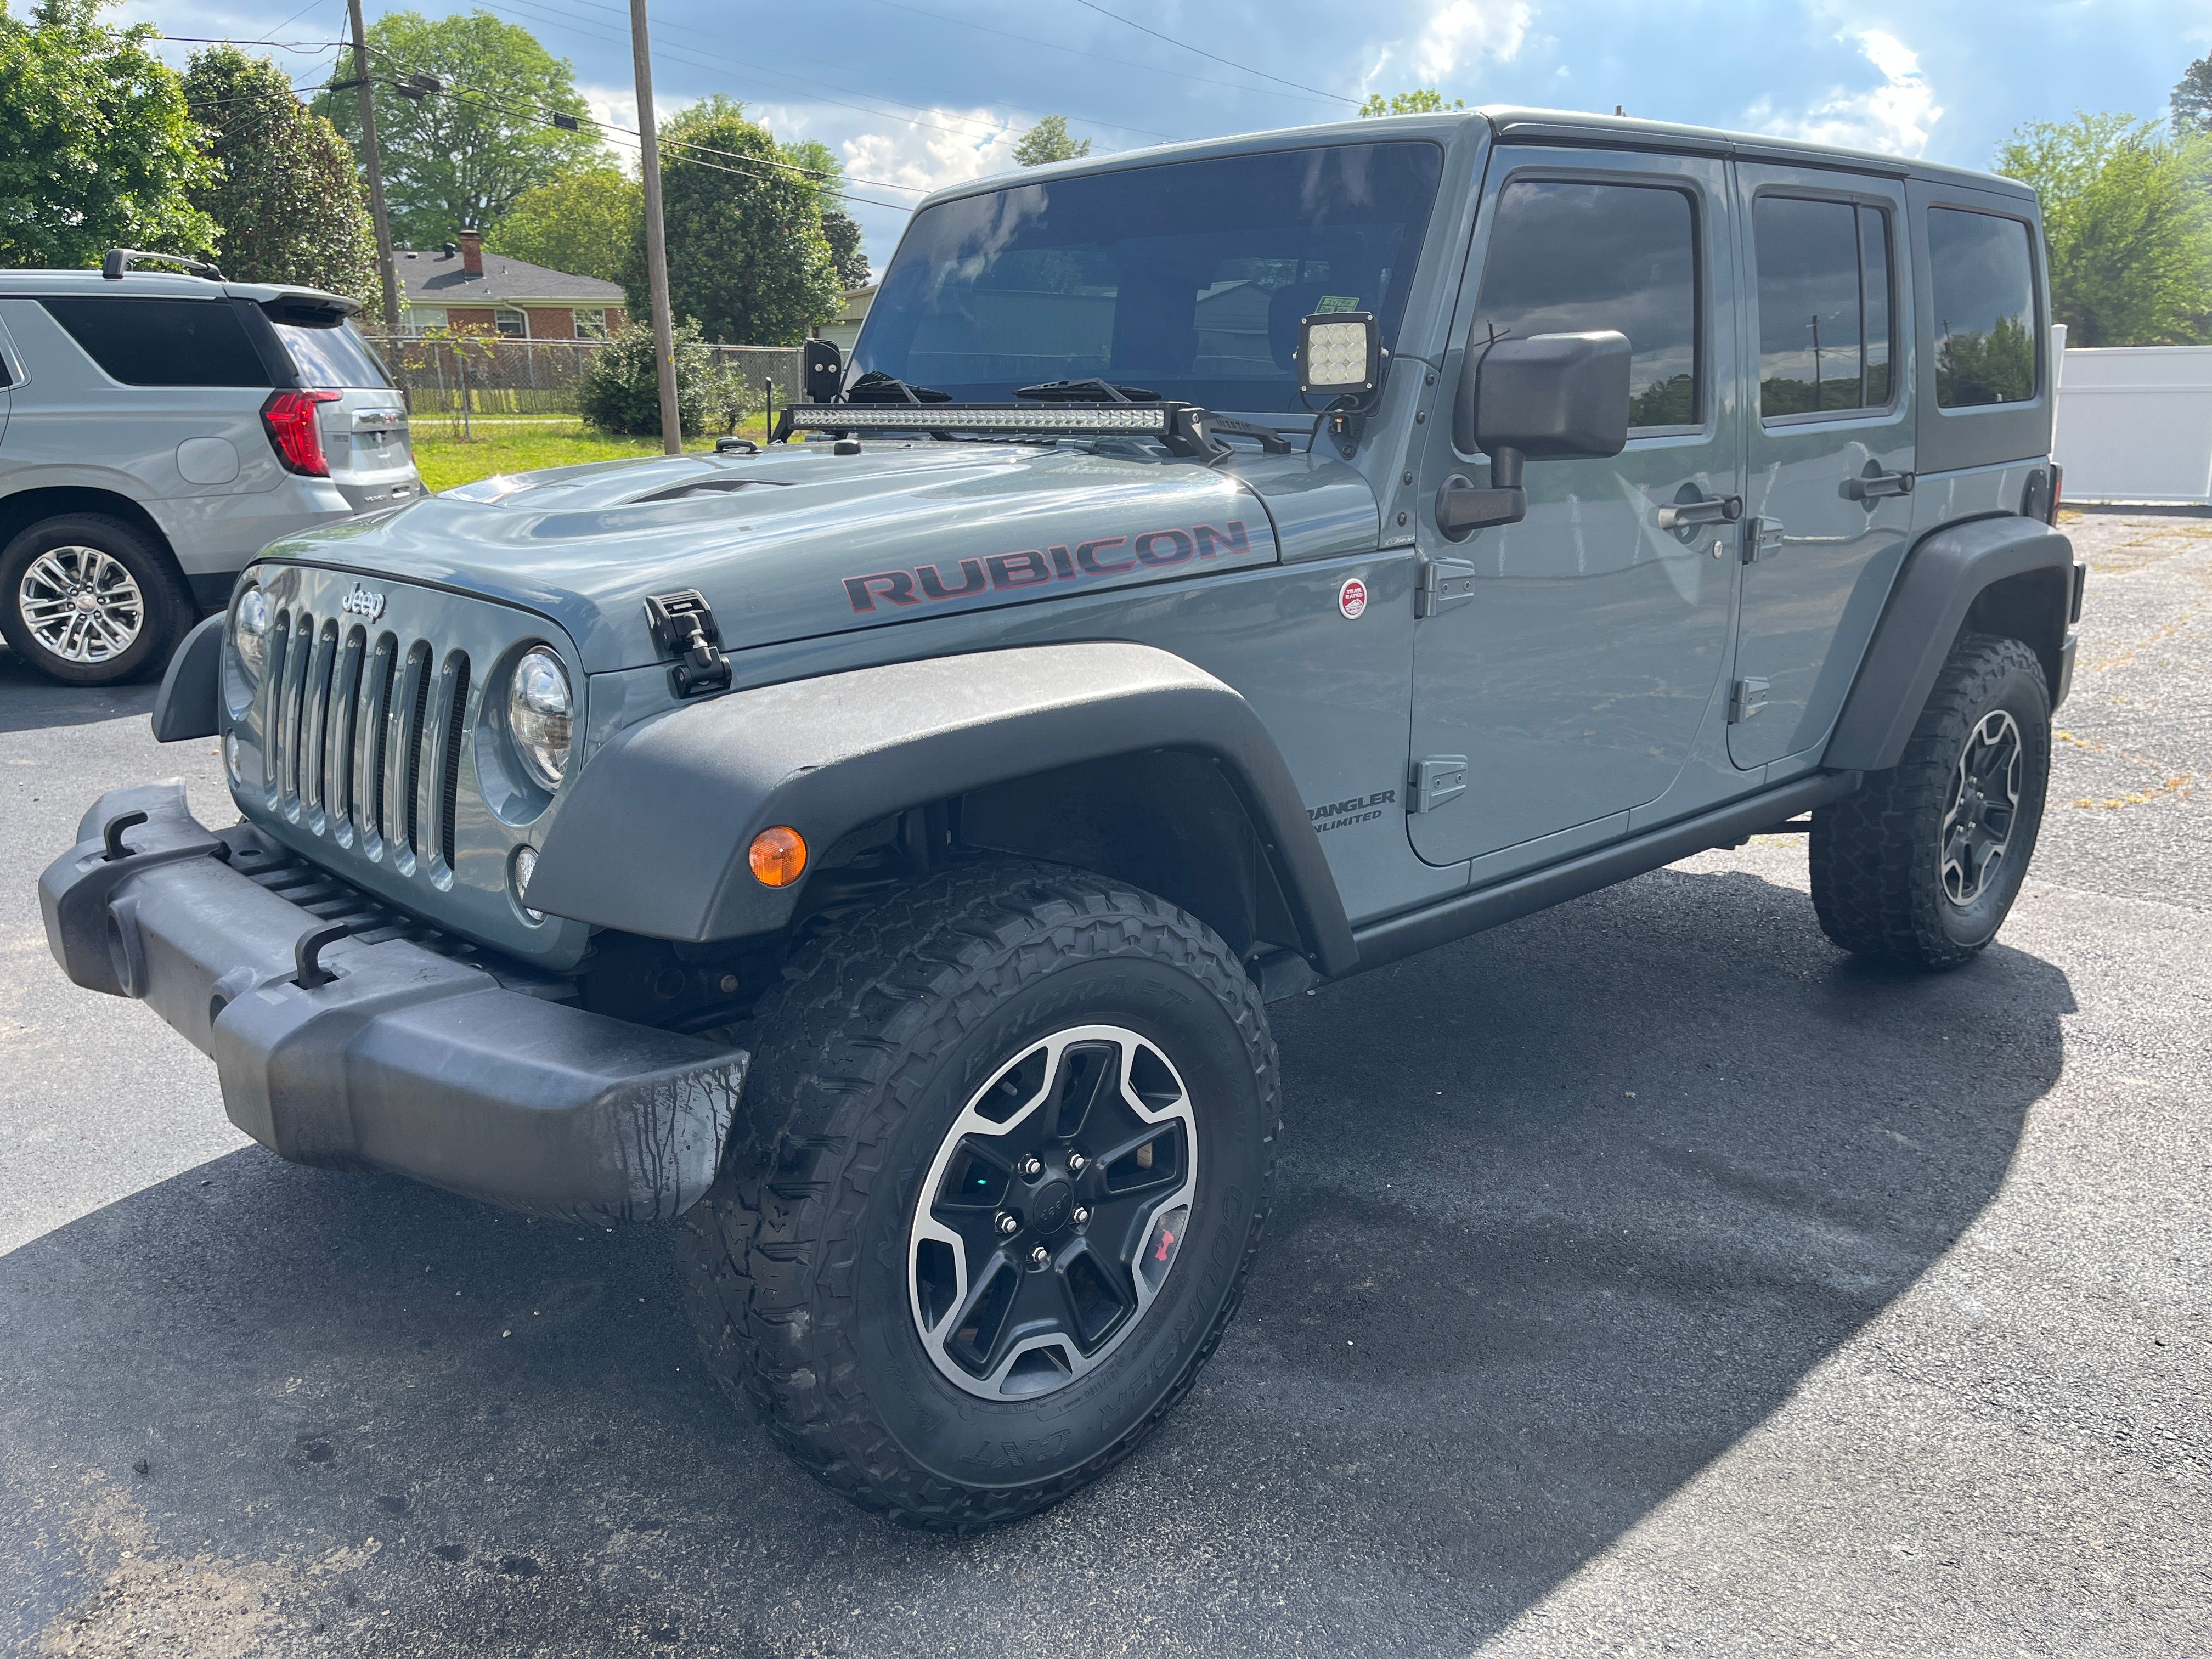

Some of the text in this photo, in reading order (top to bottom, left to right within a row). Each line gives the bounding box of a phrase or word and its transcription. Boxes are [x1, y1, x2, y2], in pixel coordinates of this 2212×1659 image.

[1215, 419, 1252, 431] WESTIN
[841, 520, 1251, 613] RUBICON
[342, 582, 385, 624] Jeep
[1307, 789, 1395, 821] RANGLER
[1313, 810, 1382, 833] NLIMITED
[1100, 1184, 1242, 1432] COURSER
[959, 1427, 1071, 1470] CXT
